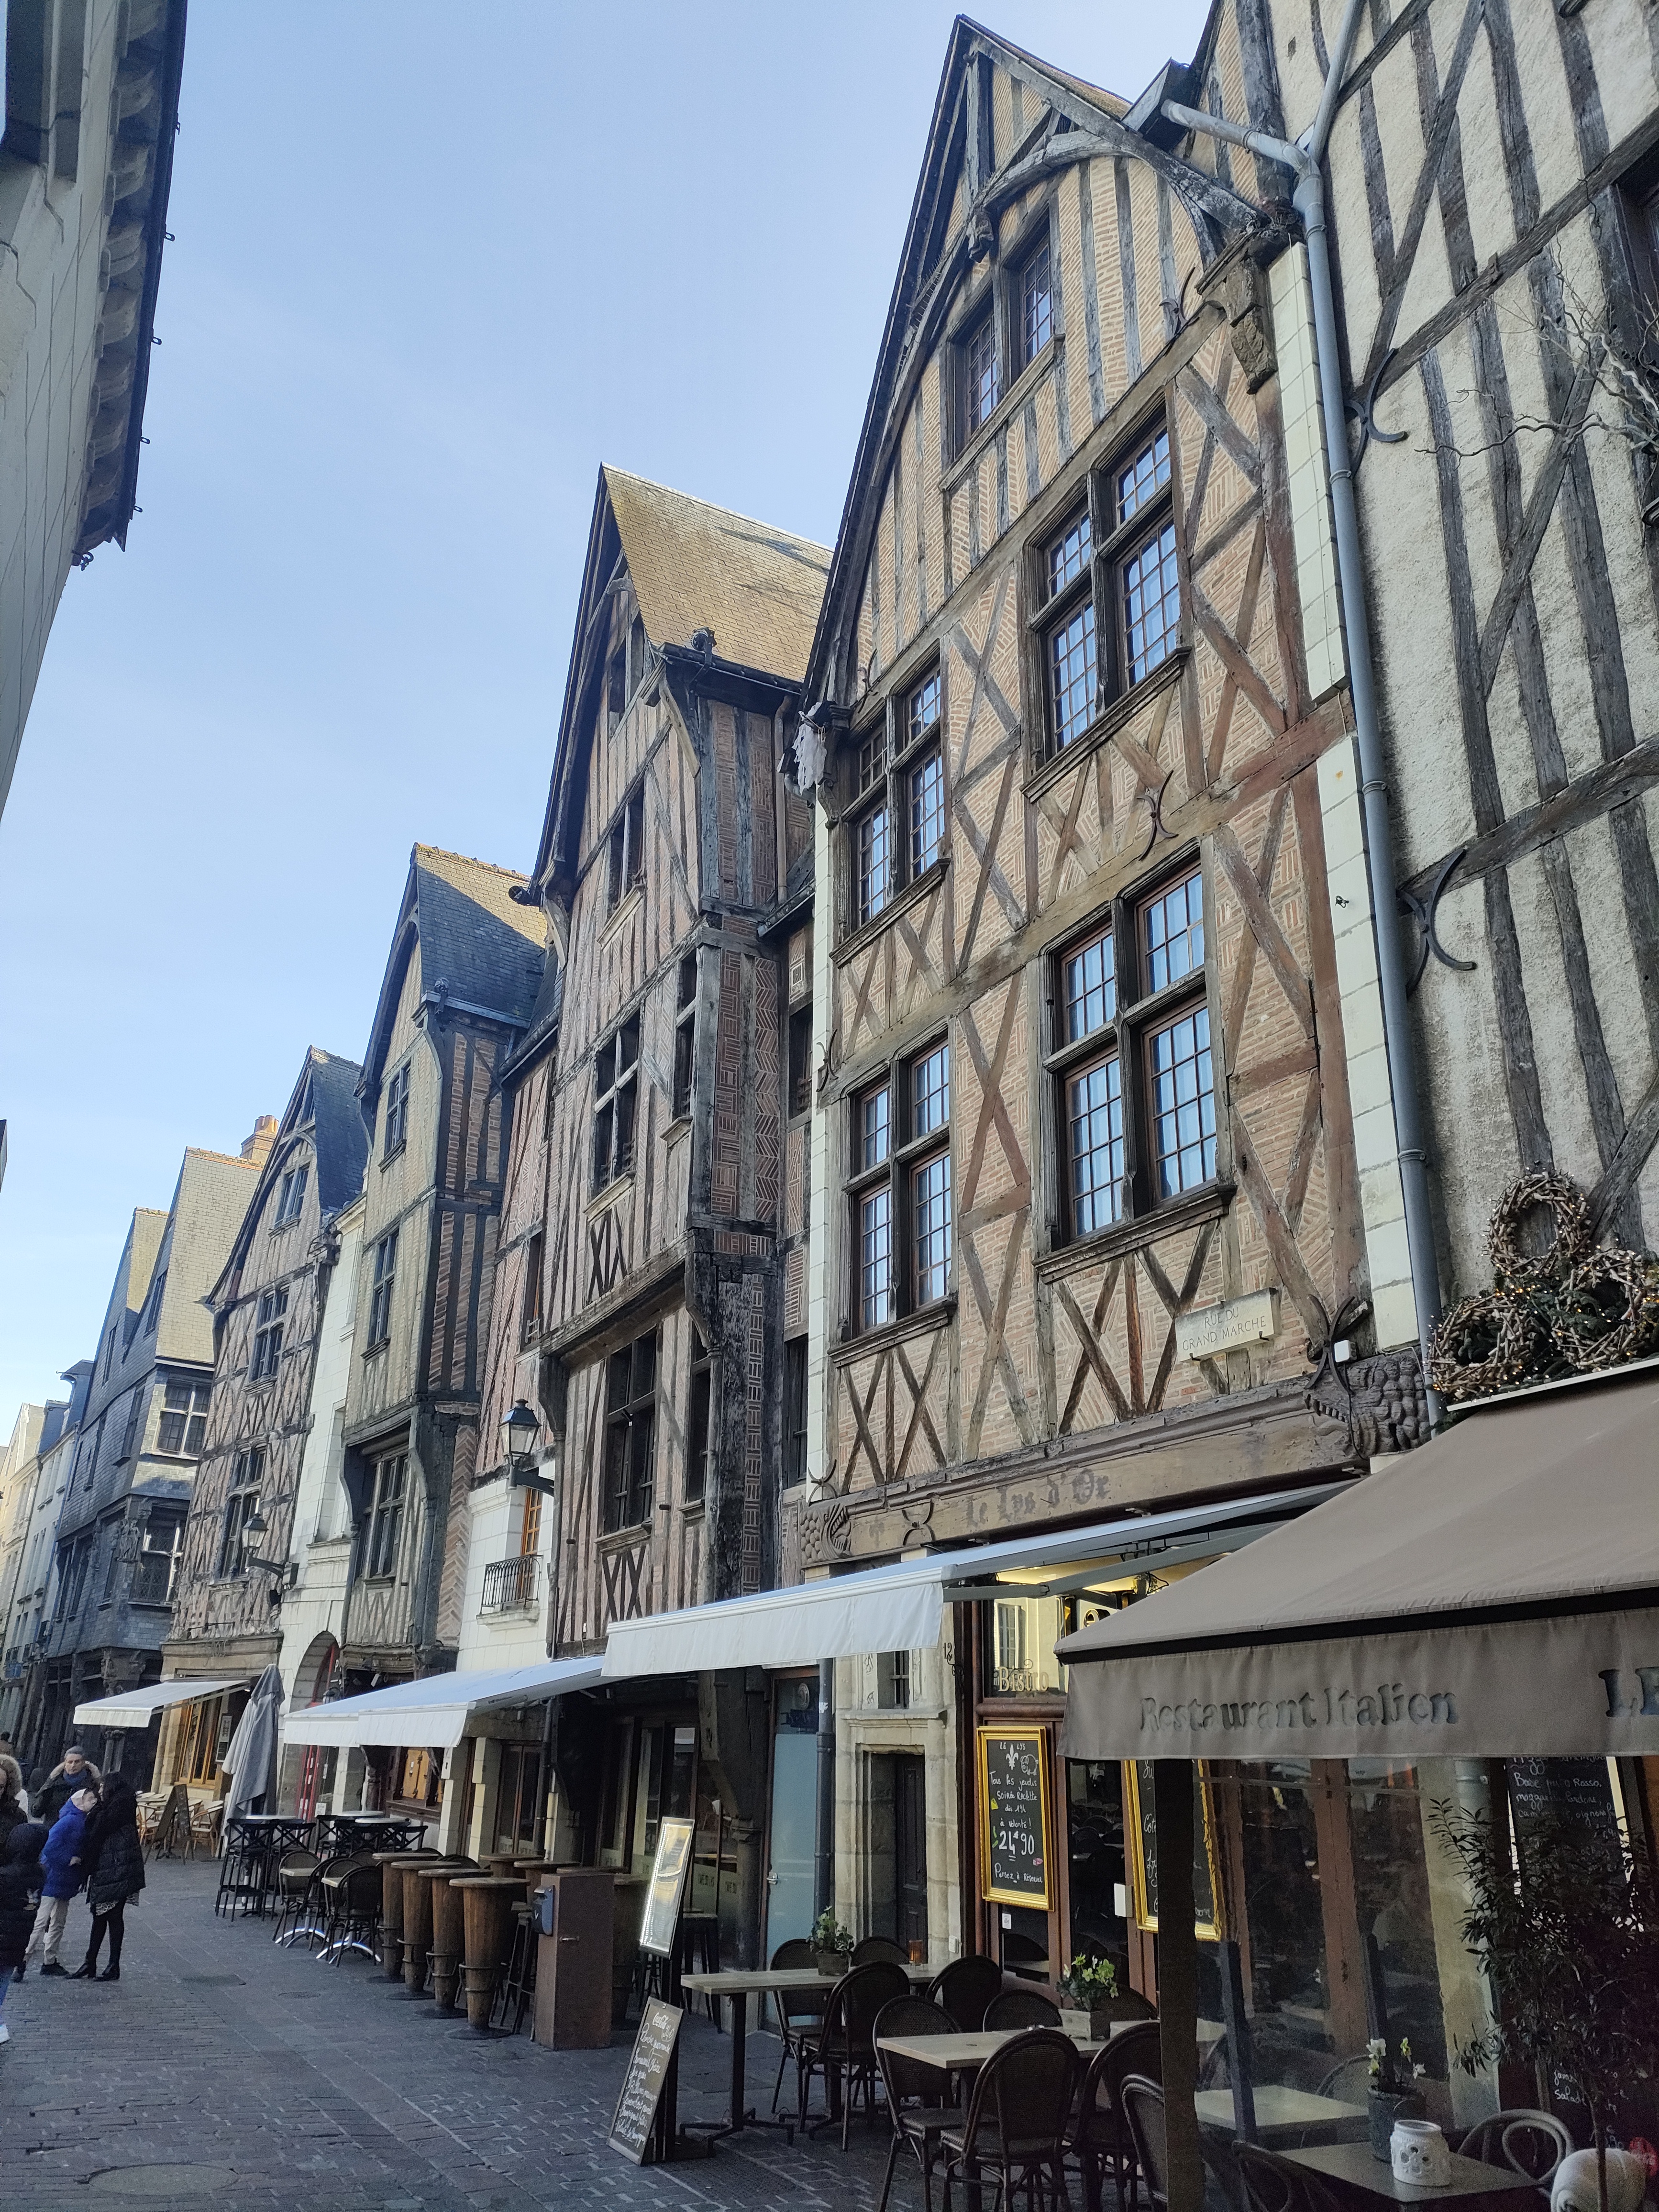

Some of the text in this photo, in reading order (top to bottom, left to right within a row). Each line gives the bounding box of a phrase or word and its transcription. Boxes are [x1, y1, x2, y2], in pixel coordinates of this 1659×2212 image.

[1205, 1307, 1239, 1328] RUE DU
[1183, 1316, 1266, 1351] GRAND MARCHE
[943, 1642, 952, 1661] 12
[998, 1665, 1050, 1692] Bistro
[1140, 1682, 1459, 1732] Restaurant Italien
[989, 1770, 1037, 1791] Tous les jeudis
[1514, 1772, 1541, 1788] Base
[1000, 1818, 1005, 1826] à
[995, 1862, 1014, 1880] Pensez
